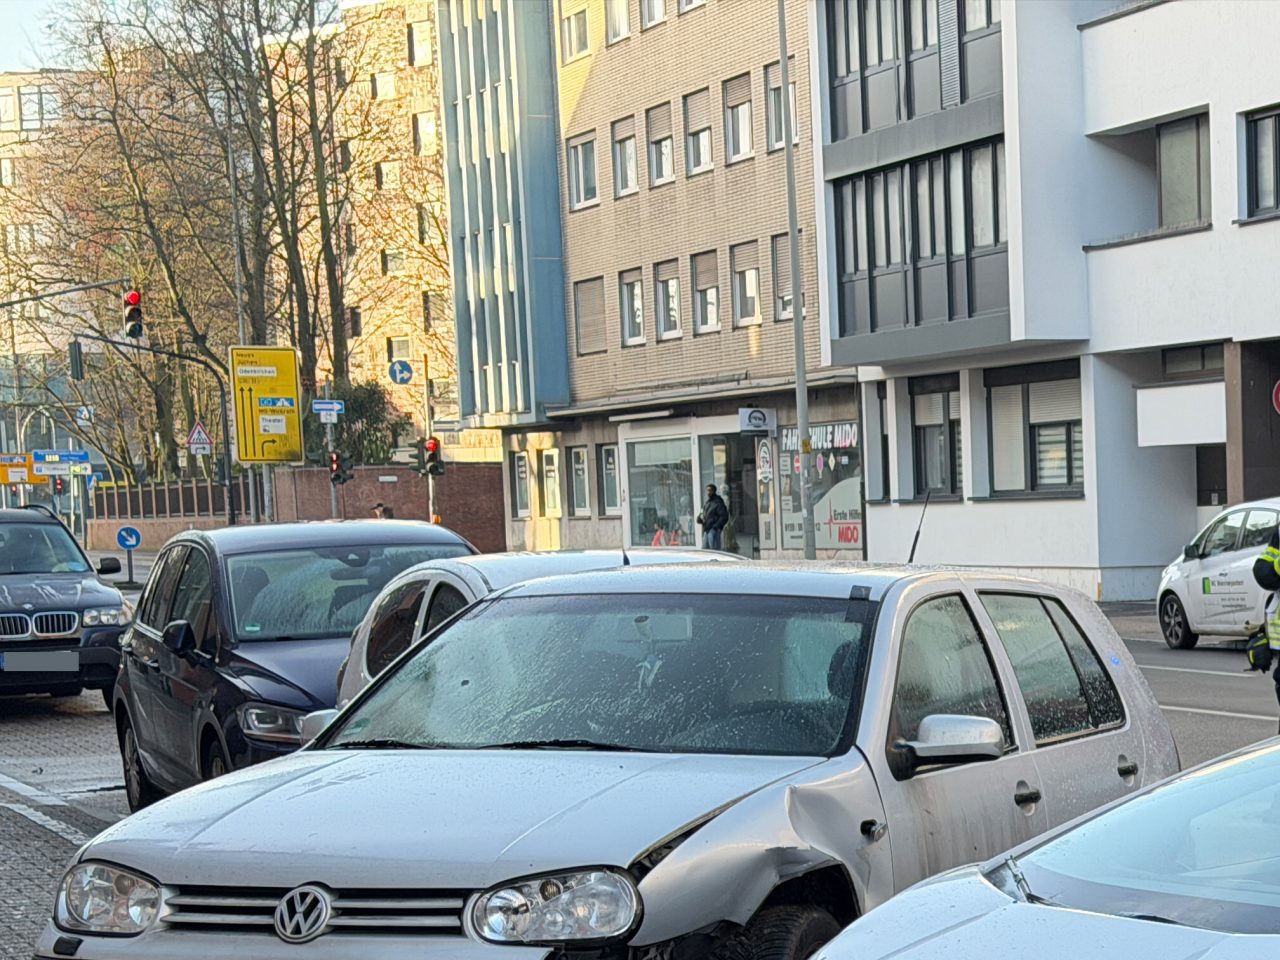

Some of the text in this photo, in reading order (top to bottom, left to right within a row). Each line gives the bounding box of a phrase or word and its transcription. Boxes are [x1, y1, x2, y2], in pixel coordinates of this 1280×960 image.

[782, 423, 858, 451] FAHHULE MIDO
[838, 526, 859, 543] MIDO
